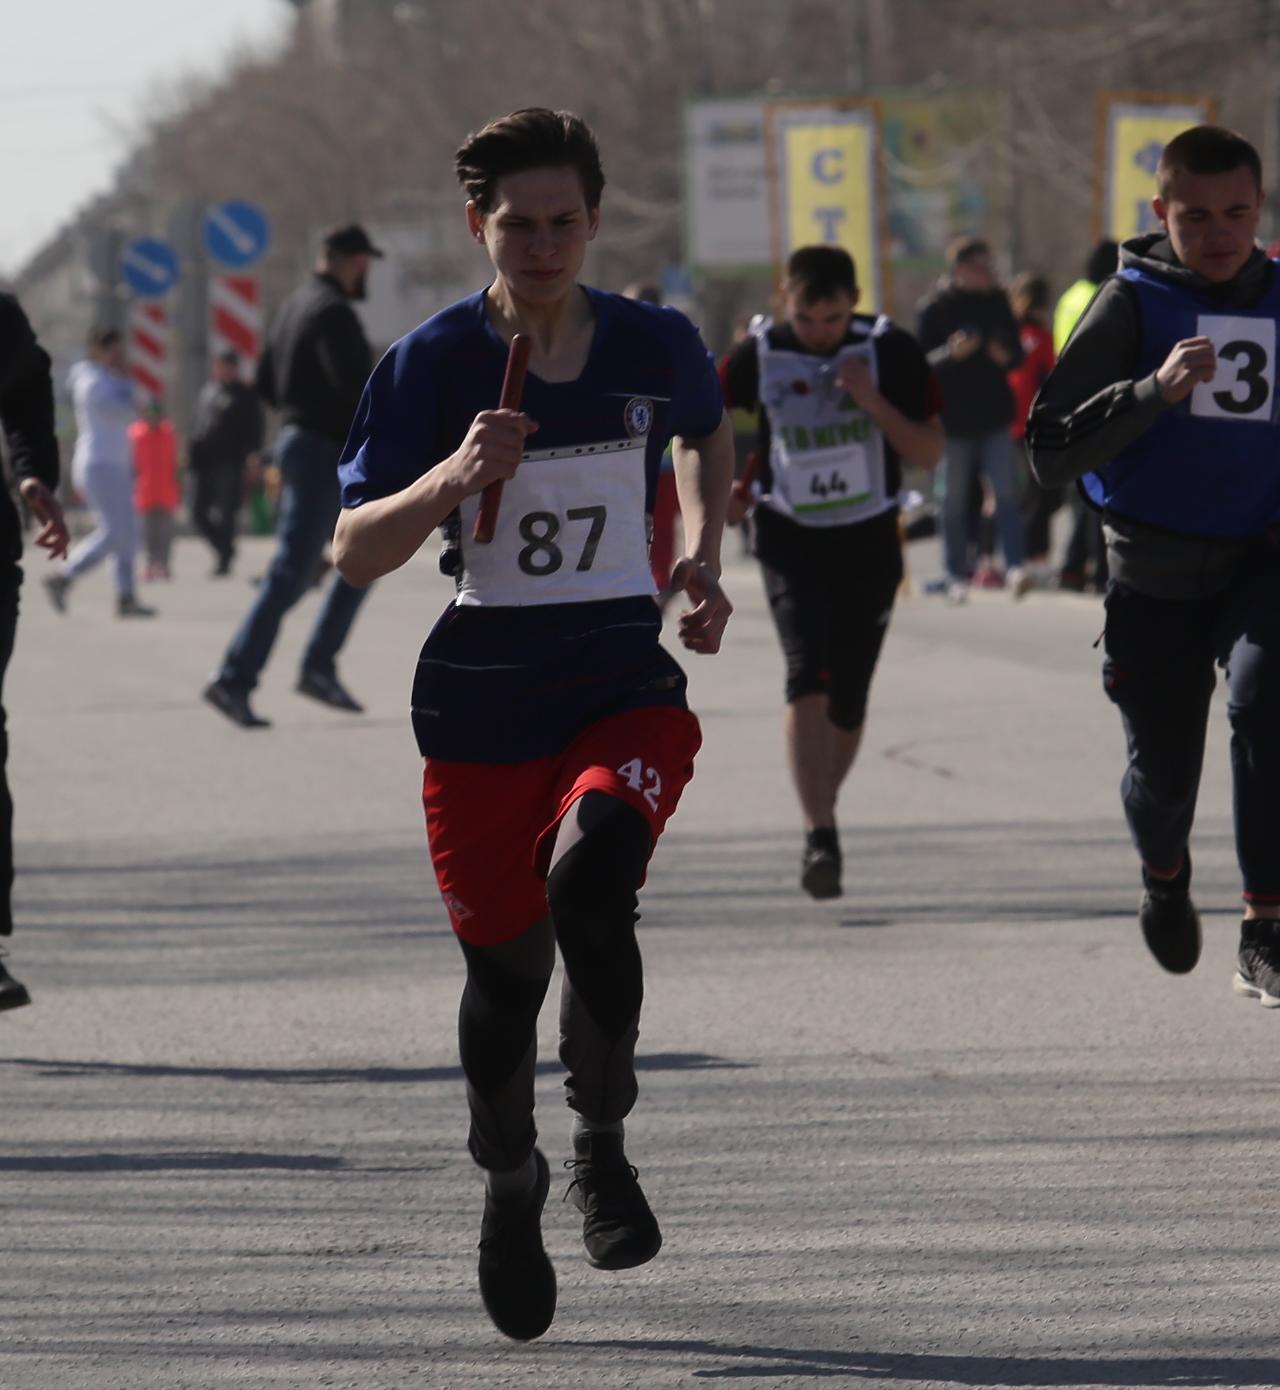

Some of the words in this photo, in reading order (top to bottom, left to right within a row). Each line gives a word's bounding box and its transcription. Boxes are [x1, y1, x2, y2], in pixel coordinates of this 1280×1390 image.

[1212, 340, 1270, 414] 3
[809, 470, 848, 497] 44
[518, 505, 607, 576] 87
[616, 757, 662, 813] 42
